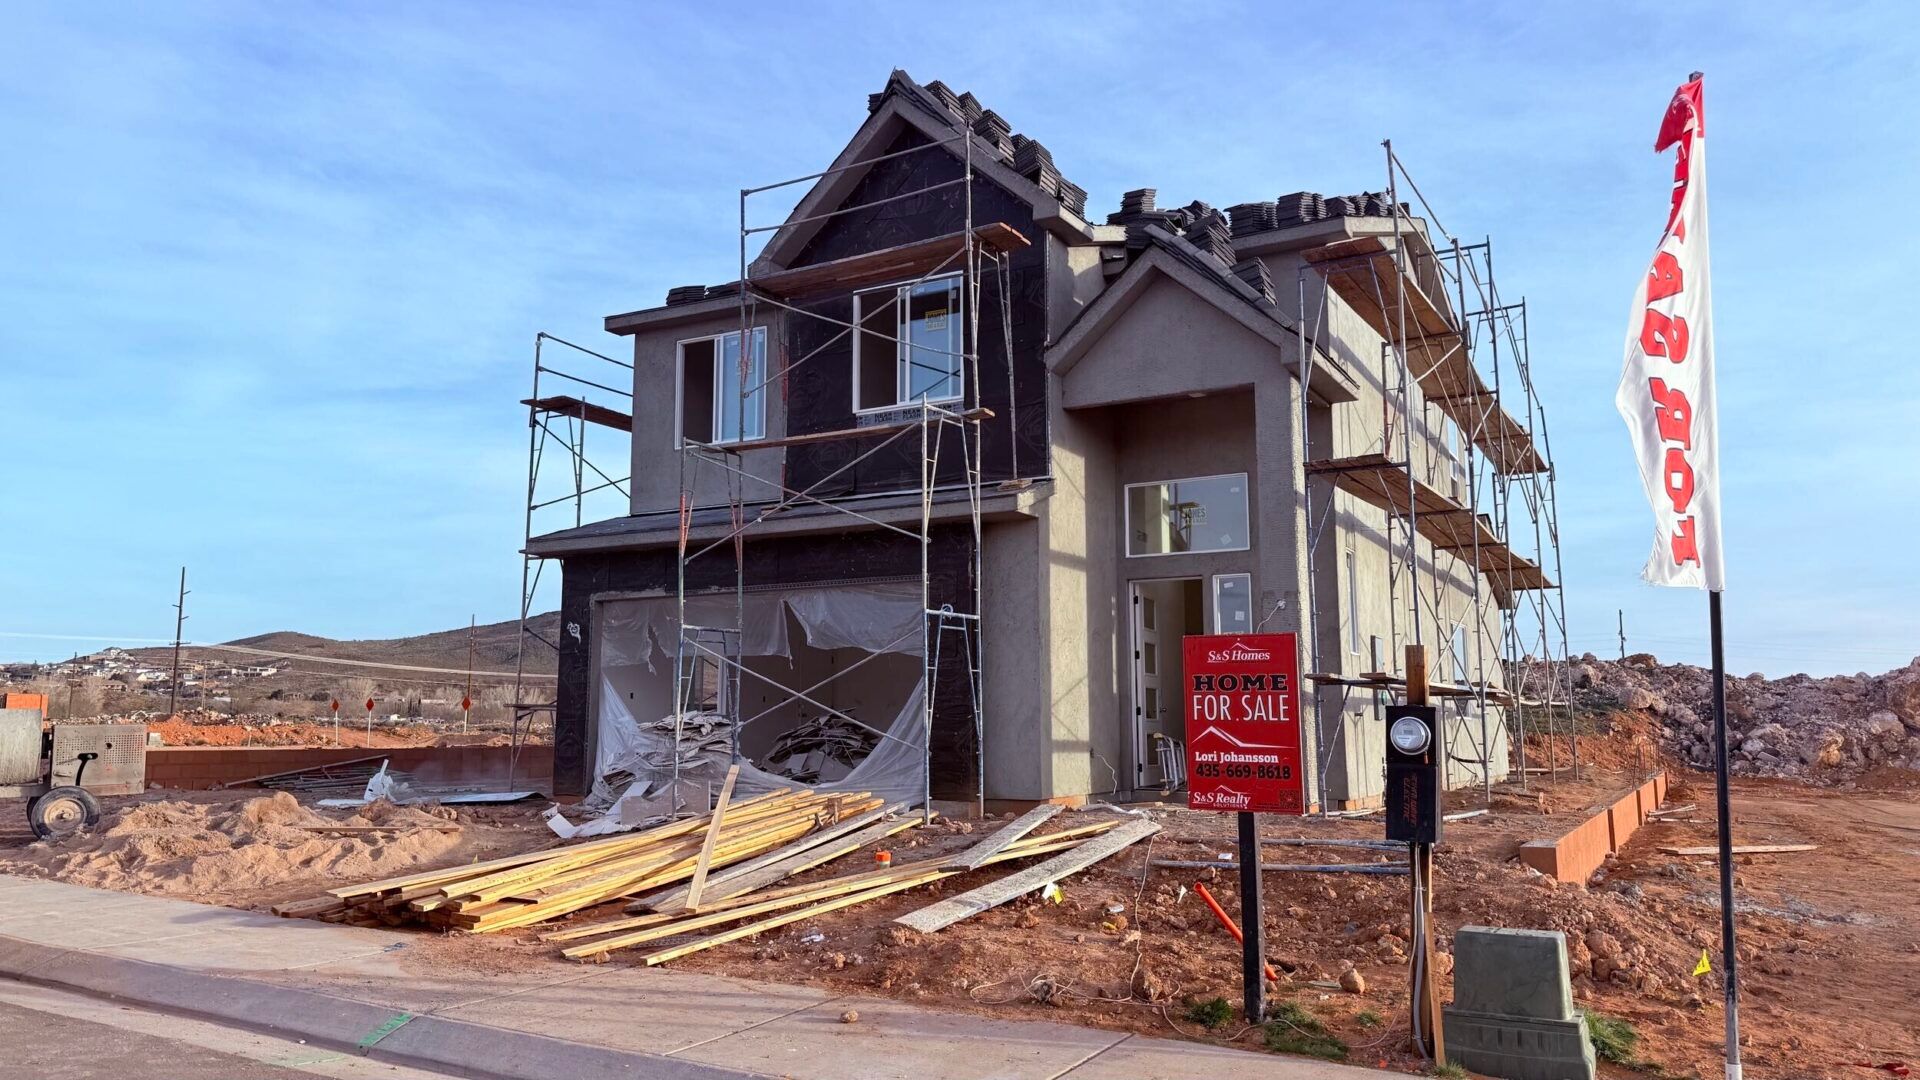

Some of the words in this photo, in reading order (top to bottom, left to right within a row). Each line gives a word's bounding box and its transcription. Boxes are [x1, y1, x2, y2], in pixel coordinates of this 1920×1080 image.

[1208, 650, 1230, 661] S&S
[1232, 650, 1271, 661] Homes
[1193, 674, 1288, 692] HOME
[1193, 695, 1231, 721] FOR
[1241, 695, 1290, 721] SALE
[1195, 751, 1218, 762] Lori
[1219, 752, 1279, 764] Johansson
[1195, 763, 1292, 780] 435-669-8618
[1193, 791, 1215, 803] S&S
[1216, 792, 1251, 806] Realty
